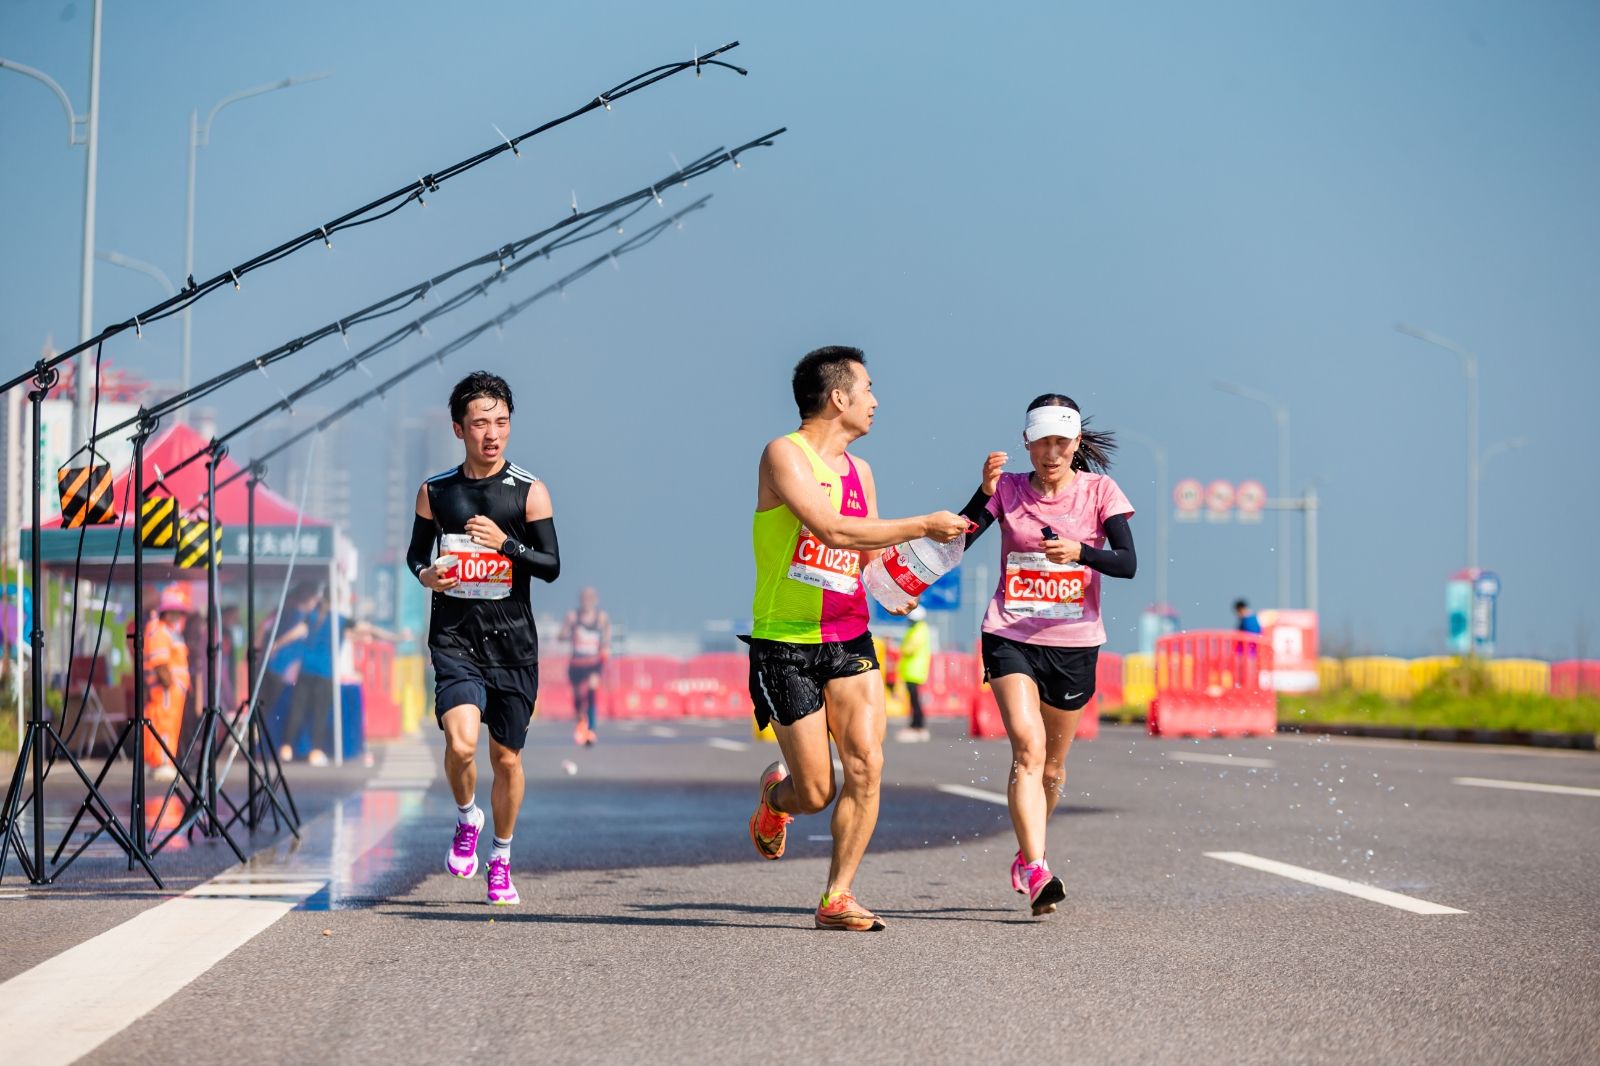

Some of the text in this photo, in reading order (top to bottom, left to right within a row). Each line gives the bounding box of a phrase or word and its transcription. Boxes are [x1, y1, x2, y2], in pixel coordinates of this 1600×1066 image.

[457, 559, 510, 580] 10022
[798, 539, 859, 575] C10237
[1008, 575, 1082, 600] C20068
